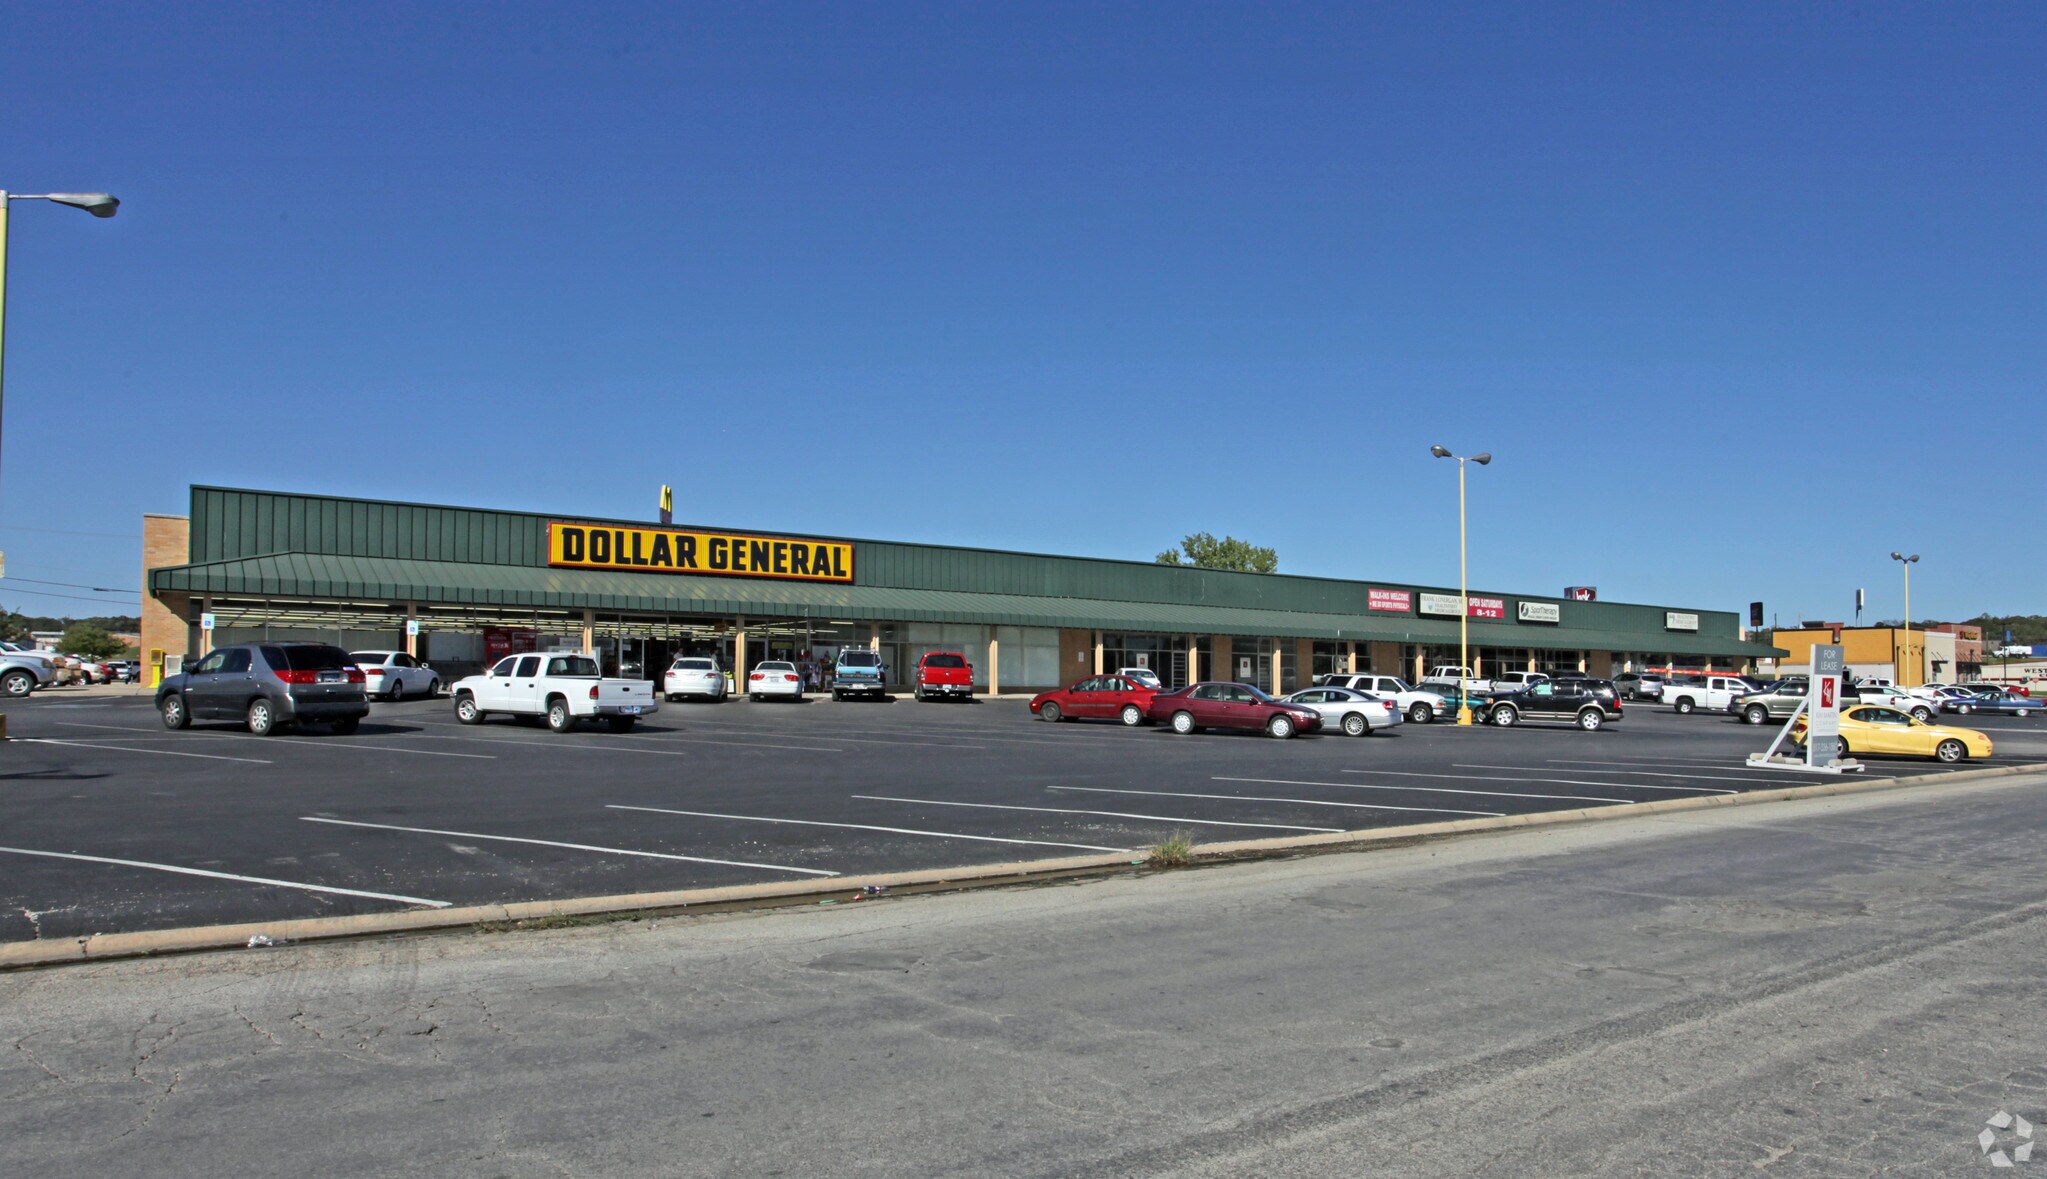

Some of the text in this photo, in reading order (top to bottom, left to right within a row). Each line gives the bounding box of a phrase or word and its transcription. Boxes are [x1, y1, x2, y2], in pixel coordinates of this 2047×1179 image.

[562, 527, 847, 577] DOLLAR GENERAL
[1370, 591, 1409, 601] WALK-INS WELCOME
[1469, 597, 1503, 609] OPEN SATURDAYS
[1476, 609, 1496, 617] 8-12
[1824, 650, 1836, 659] FOR
[1821, 661, 1838, 671] LEASE
